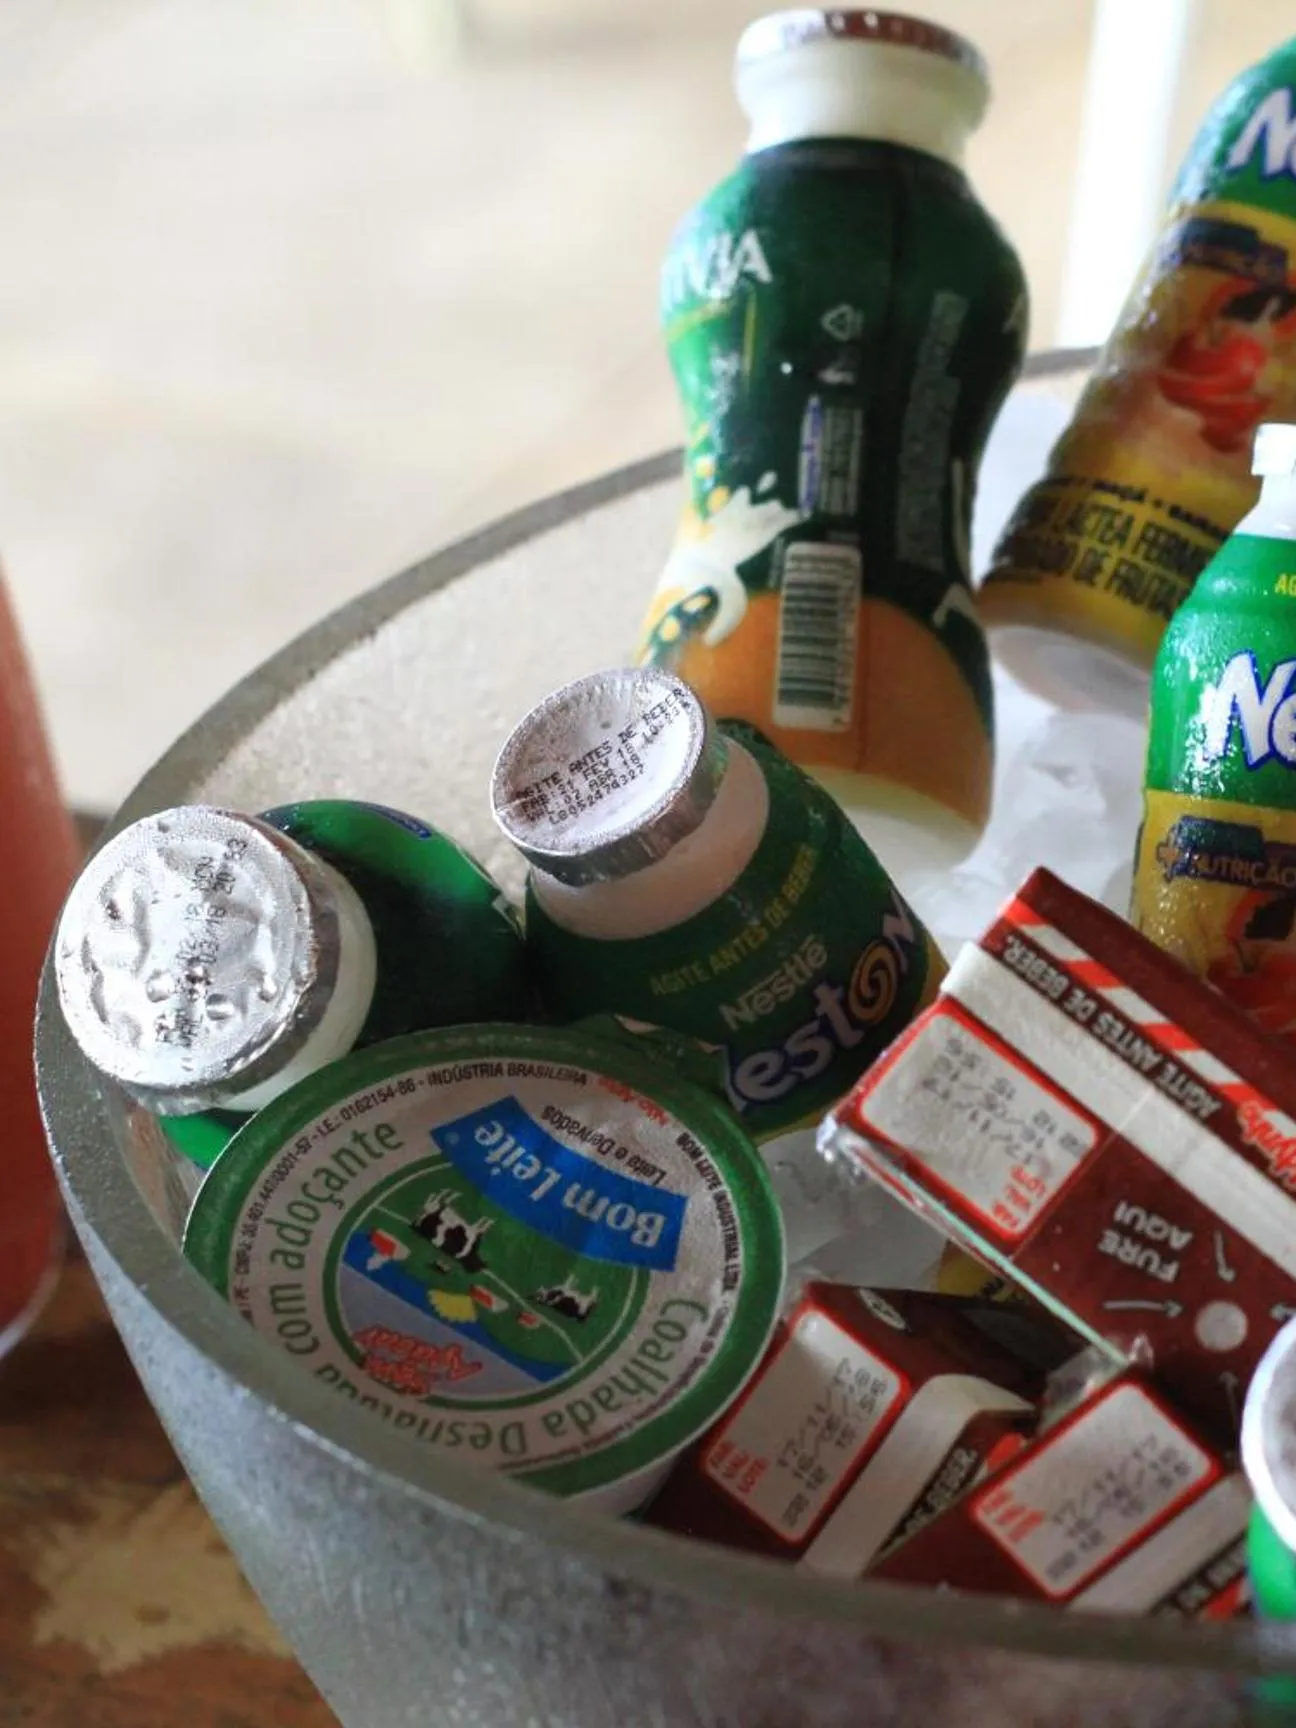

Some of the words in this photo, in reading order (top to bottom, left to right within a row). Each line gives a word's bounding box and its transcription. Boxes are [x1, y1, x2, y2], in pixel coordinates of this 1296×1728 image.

[567, 741, 613, 774] ANTES
[719, 934, 829, 1032] Nestlé
[725, 888, 916, 1113] eston
[1068, 989, 1095, 1019] DE
[427, 1061, 504, 1088] INDÚSTRIA
[507, 1061, 588, 1087] BRASILEIRA
[1096, 1010, 1166, 1075] ANTES
[1160, 1066, 1222, 1119] AGITE
[473, 1120, 562, 1202] Leite
[266, 1121, 405, 1271] adoçante
[563, 1182, 667, 1248] Bom
[1113, 1201, 1194, 1251] AQUI
[1098, 1228, 1181, 1283] FURE
[268, 1283, 321, 1355] com
[541, 1298, 709, 1437] Coalhada
